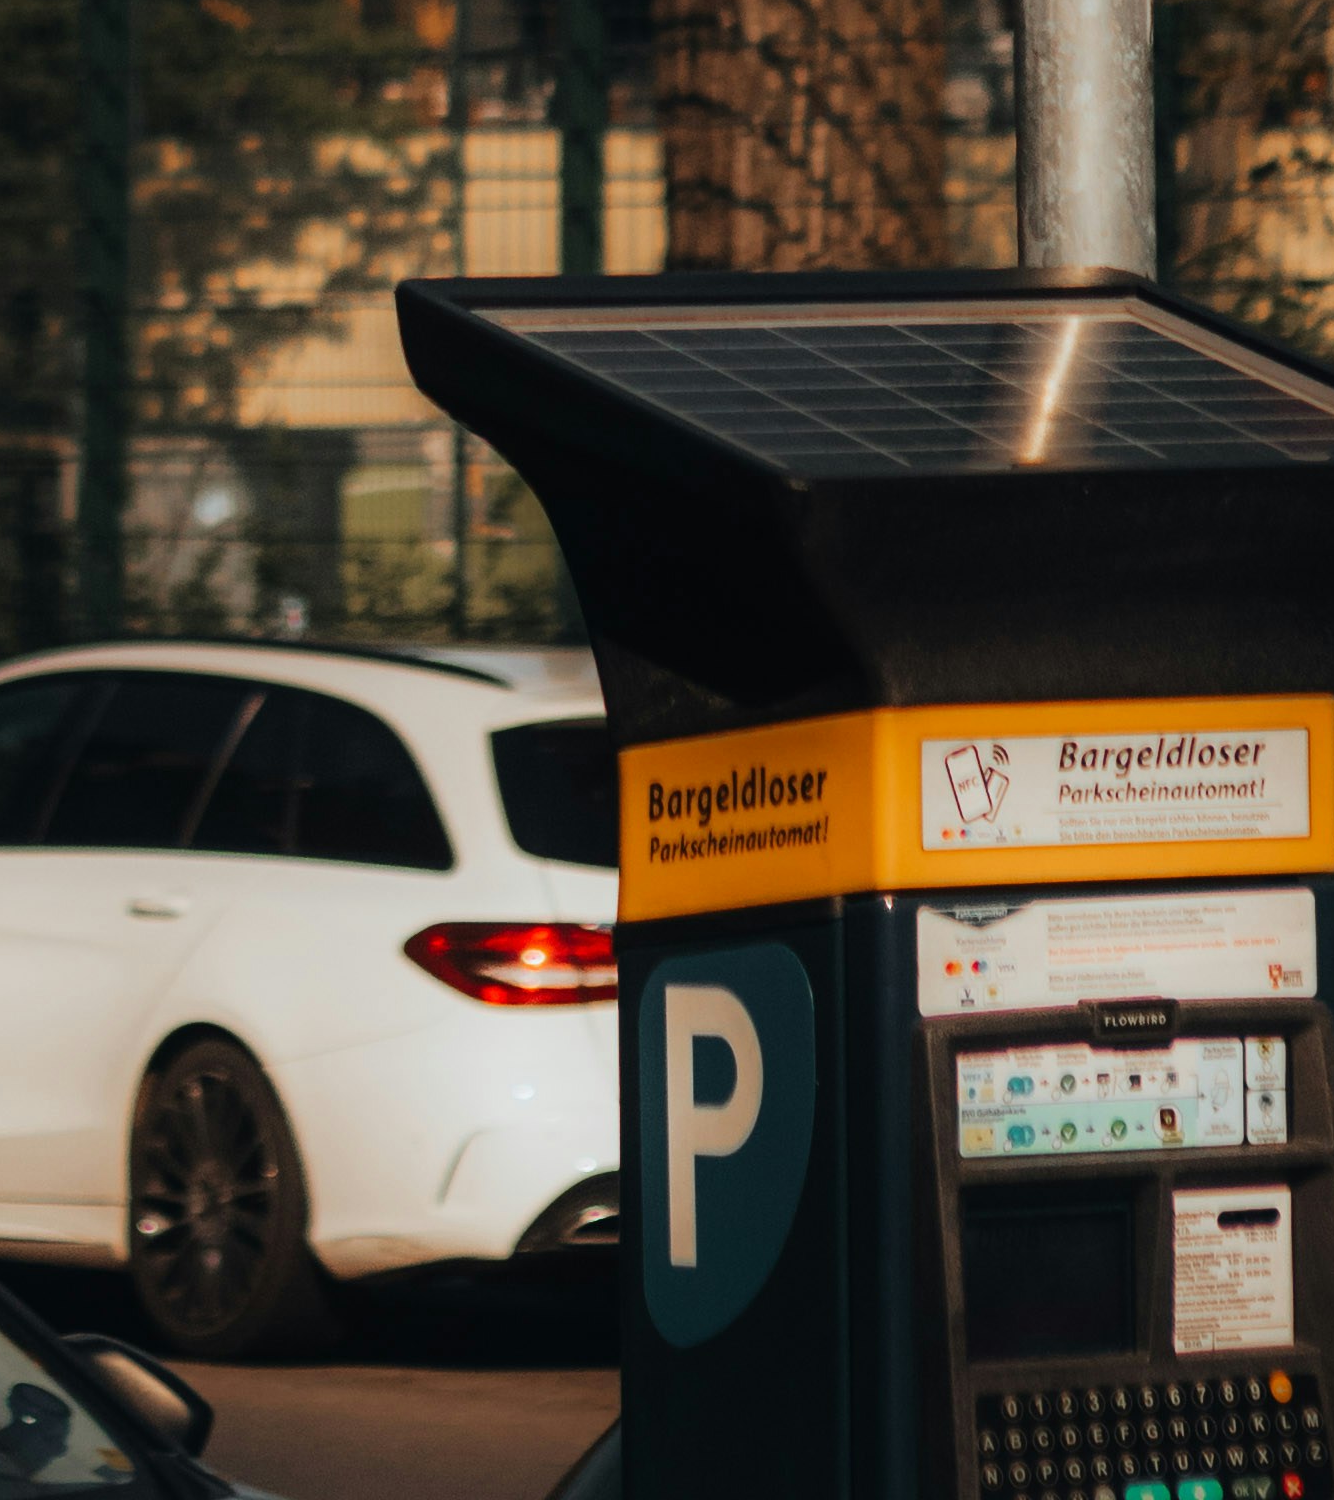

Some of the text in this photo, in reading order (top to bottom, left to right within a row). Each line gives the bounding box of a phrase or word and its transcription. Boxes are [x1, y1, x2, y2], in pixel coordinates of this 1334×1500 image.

[1058, 737, 1267, 778] Bargeldloser
[648, 766, 828, 828] Bargeldloser
[1058, 778, 1266, 804] Parkscheinautomat!
[650, 815, 829, 864] Parkscheinautomat!
[1104, 1014, 1167, 1028] FLOWBIRD
[665, 983, 764, 1269] P
[1007, 1382, 1260, 1418] 0 1 2 3 4 5 6 7 8 9
[984, 1435, 994, 1451] A
[1010, 1433, 1021, 1449] B
[1038, 1431, 1049, 1447] C
[1066, 1429, 1076, 1445] D
[1093, 1428, 1103, 1444] E
[1120, 1425, 1129, 1441] F
[1146, 1423, 1158, 1439] G
[1174, 1420, 1184, 1437] H
[1228, 1418, 1236, 1434] J
[1254, 1415, 1265, 1431] K
[1282, 1414, 1291, 1430] L
[1306, 1412, 1318, 1428] M
[986, 1445, 1320, 1484] N O P Q R S T U V W X Y Z
